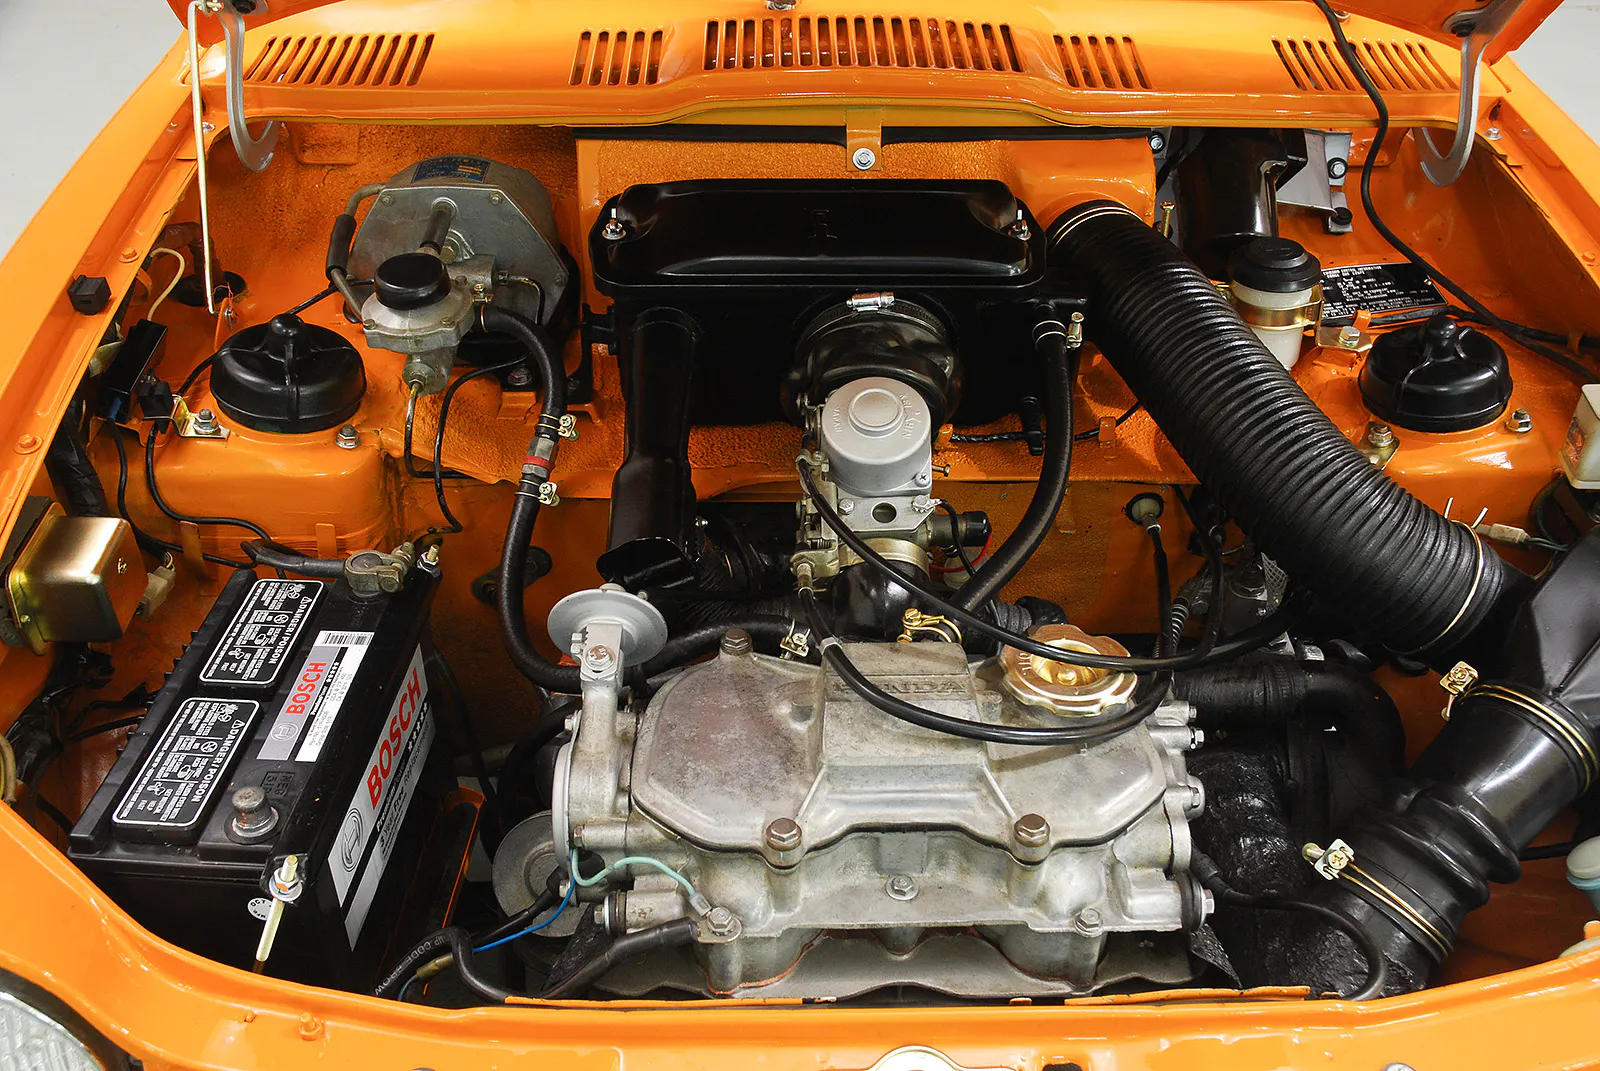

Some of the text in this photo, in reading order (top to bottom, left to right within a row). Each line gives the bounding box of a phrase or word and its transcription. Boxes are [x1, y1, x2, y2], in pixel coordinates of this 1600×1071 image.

[267, 604, 306, 663] DANGER/POISON
[283, 661, 327, 715] BOSCH
[366, 663, 422, 812] BOSCH
[190, 729, 238, 802] DANGER/POISON
[393, 782, 404, 813] Free
[250, 899, 266, 907] OCT
[404, 941, 432, 965] CODE
